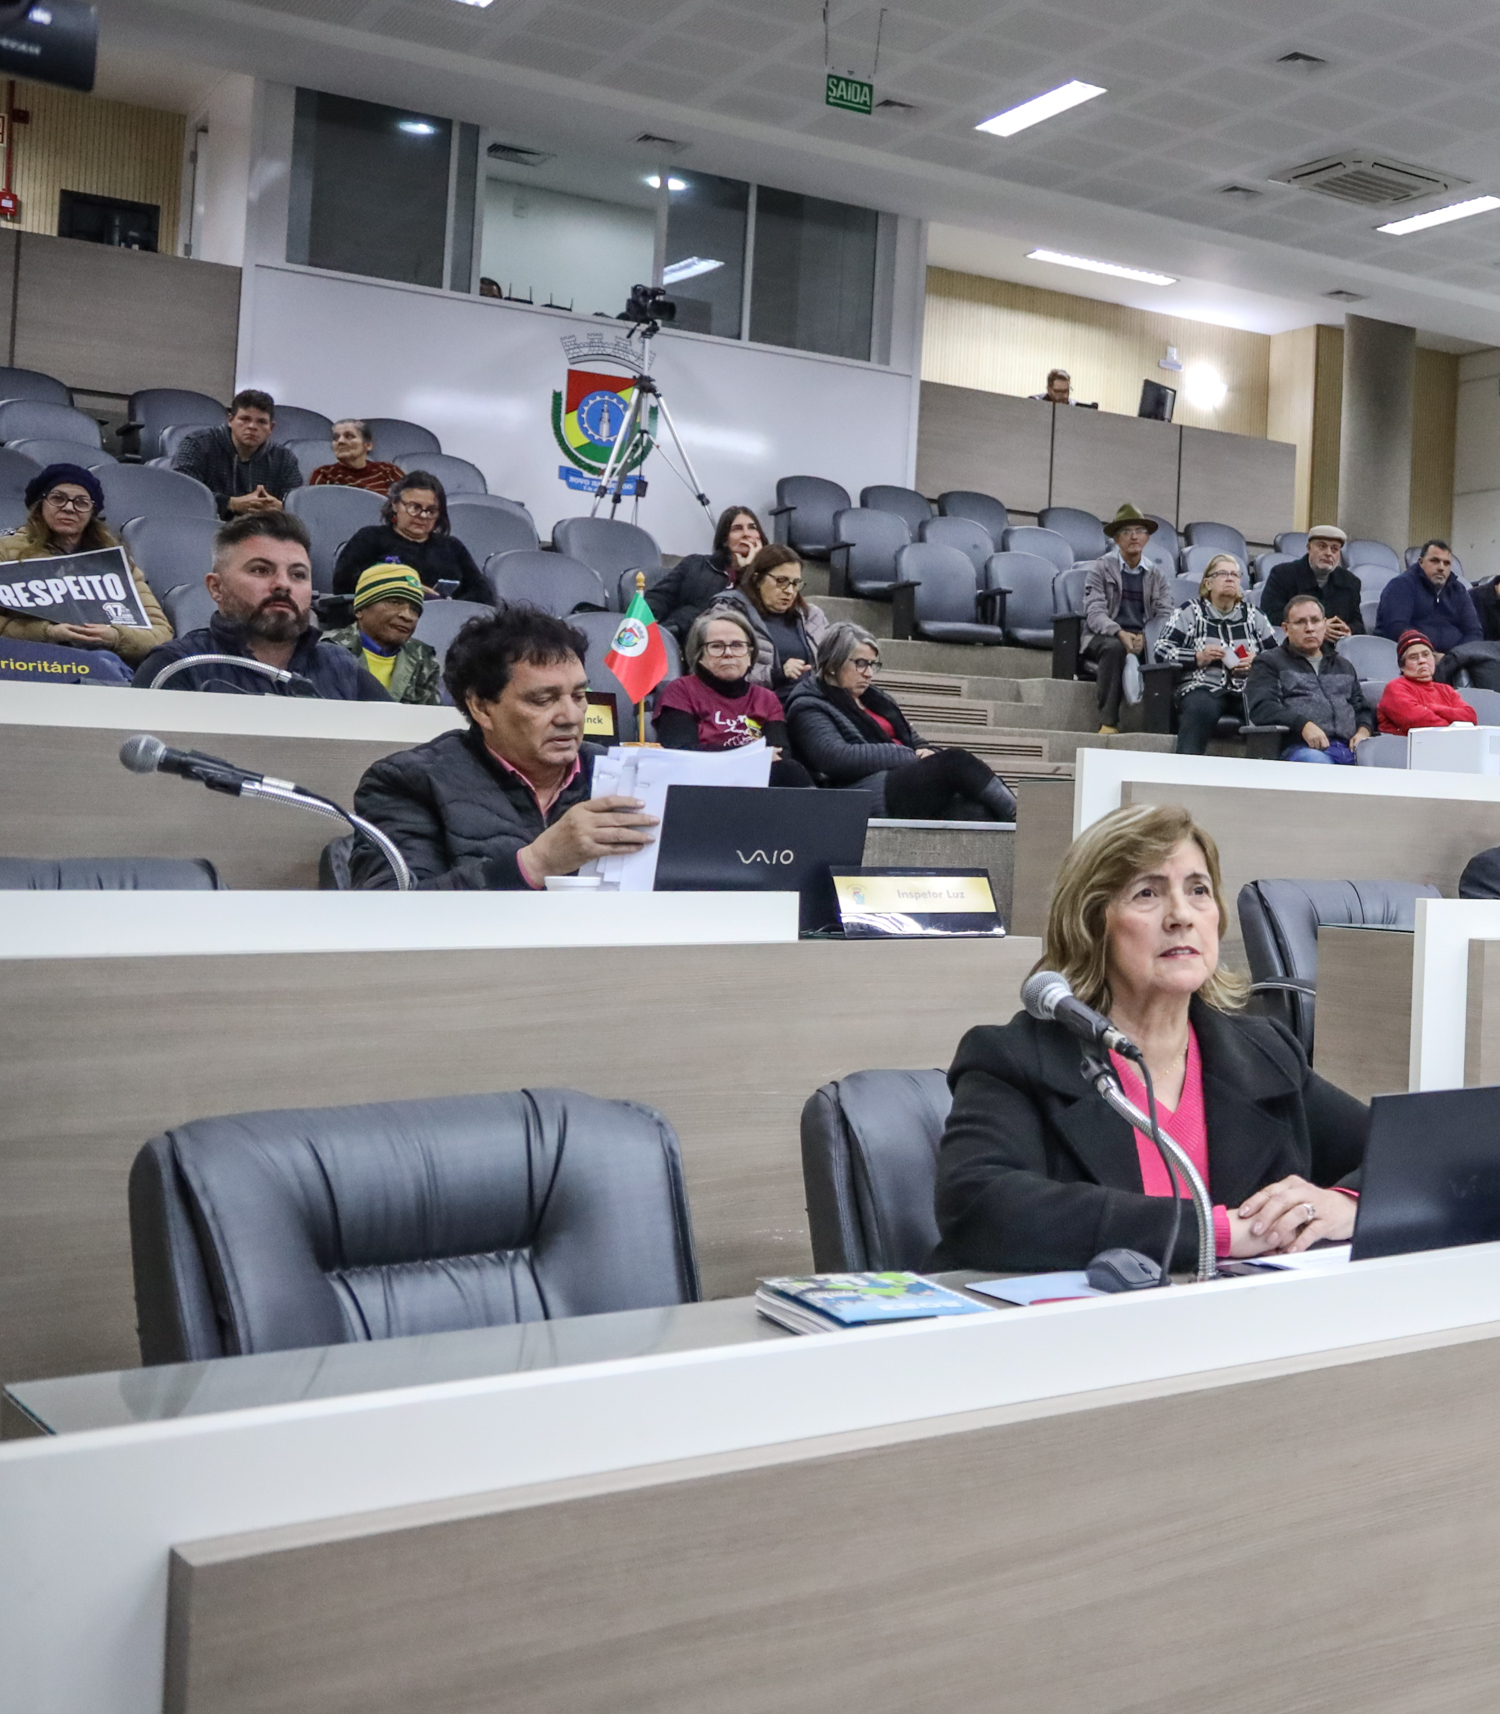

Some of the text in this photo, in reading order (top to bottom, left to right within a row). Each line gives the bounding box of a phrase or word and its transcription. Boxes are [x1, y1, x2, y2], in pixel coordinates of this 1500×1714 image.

[0, 573, 127, 607] RESPEITO
[0, 658, 90, 674] rioritário
[585, 715, 603, 725] nck
[736, 849, 794, 865] VAIO
[897, 888, 966, 901] Inspetor Luz
